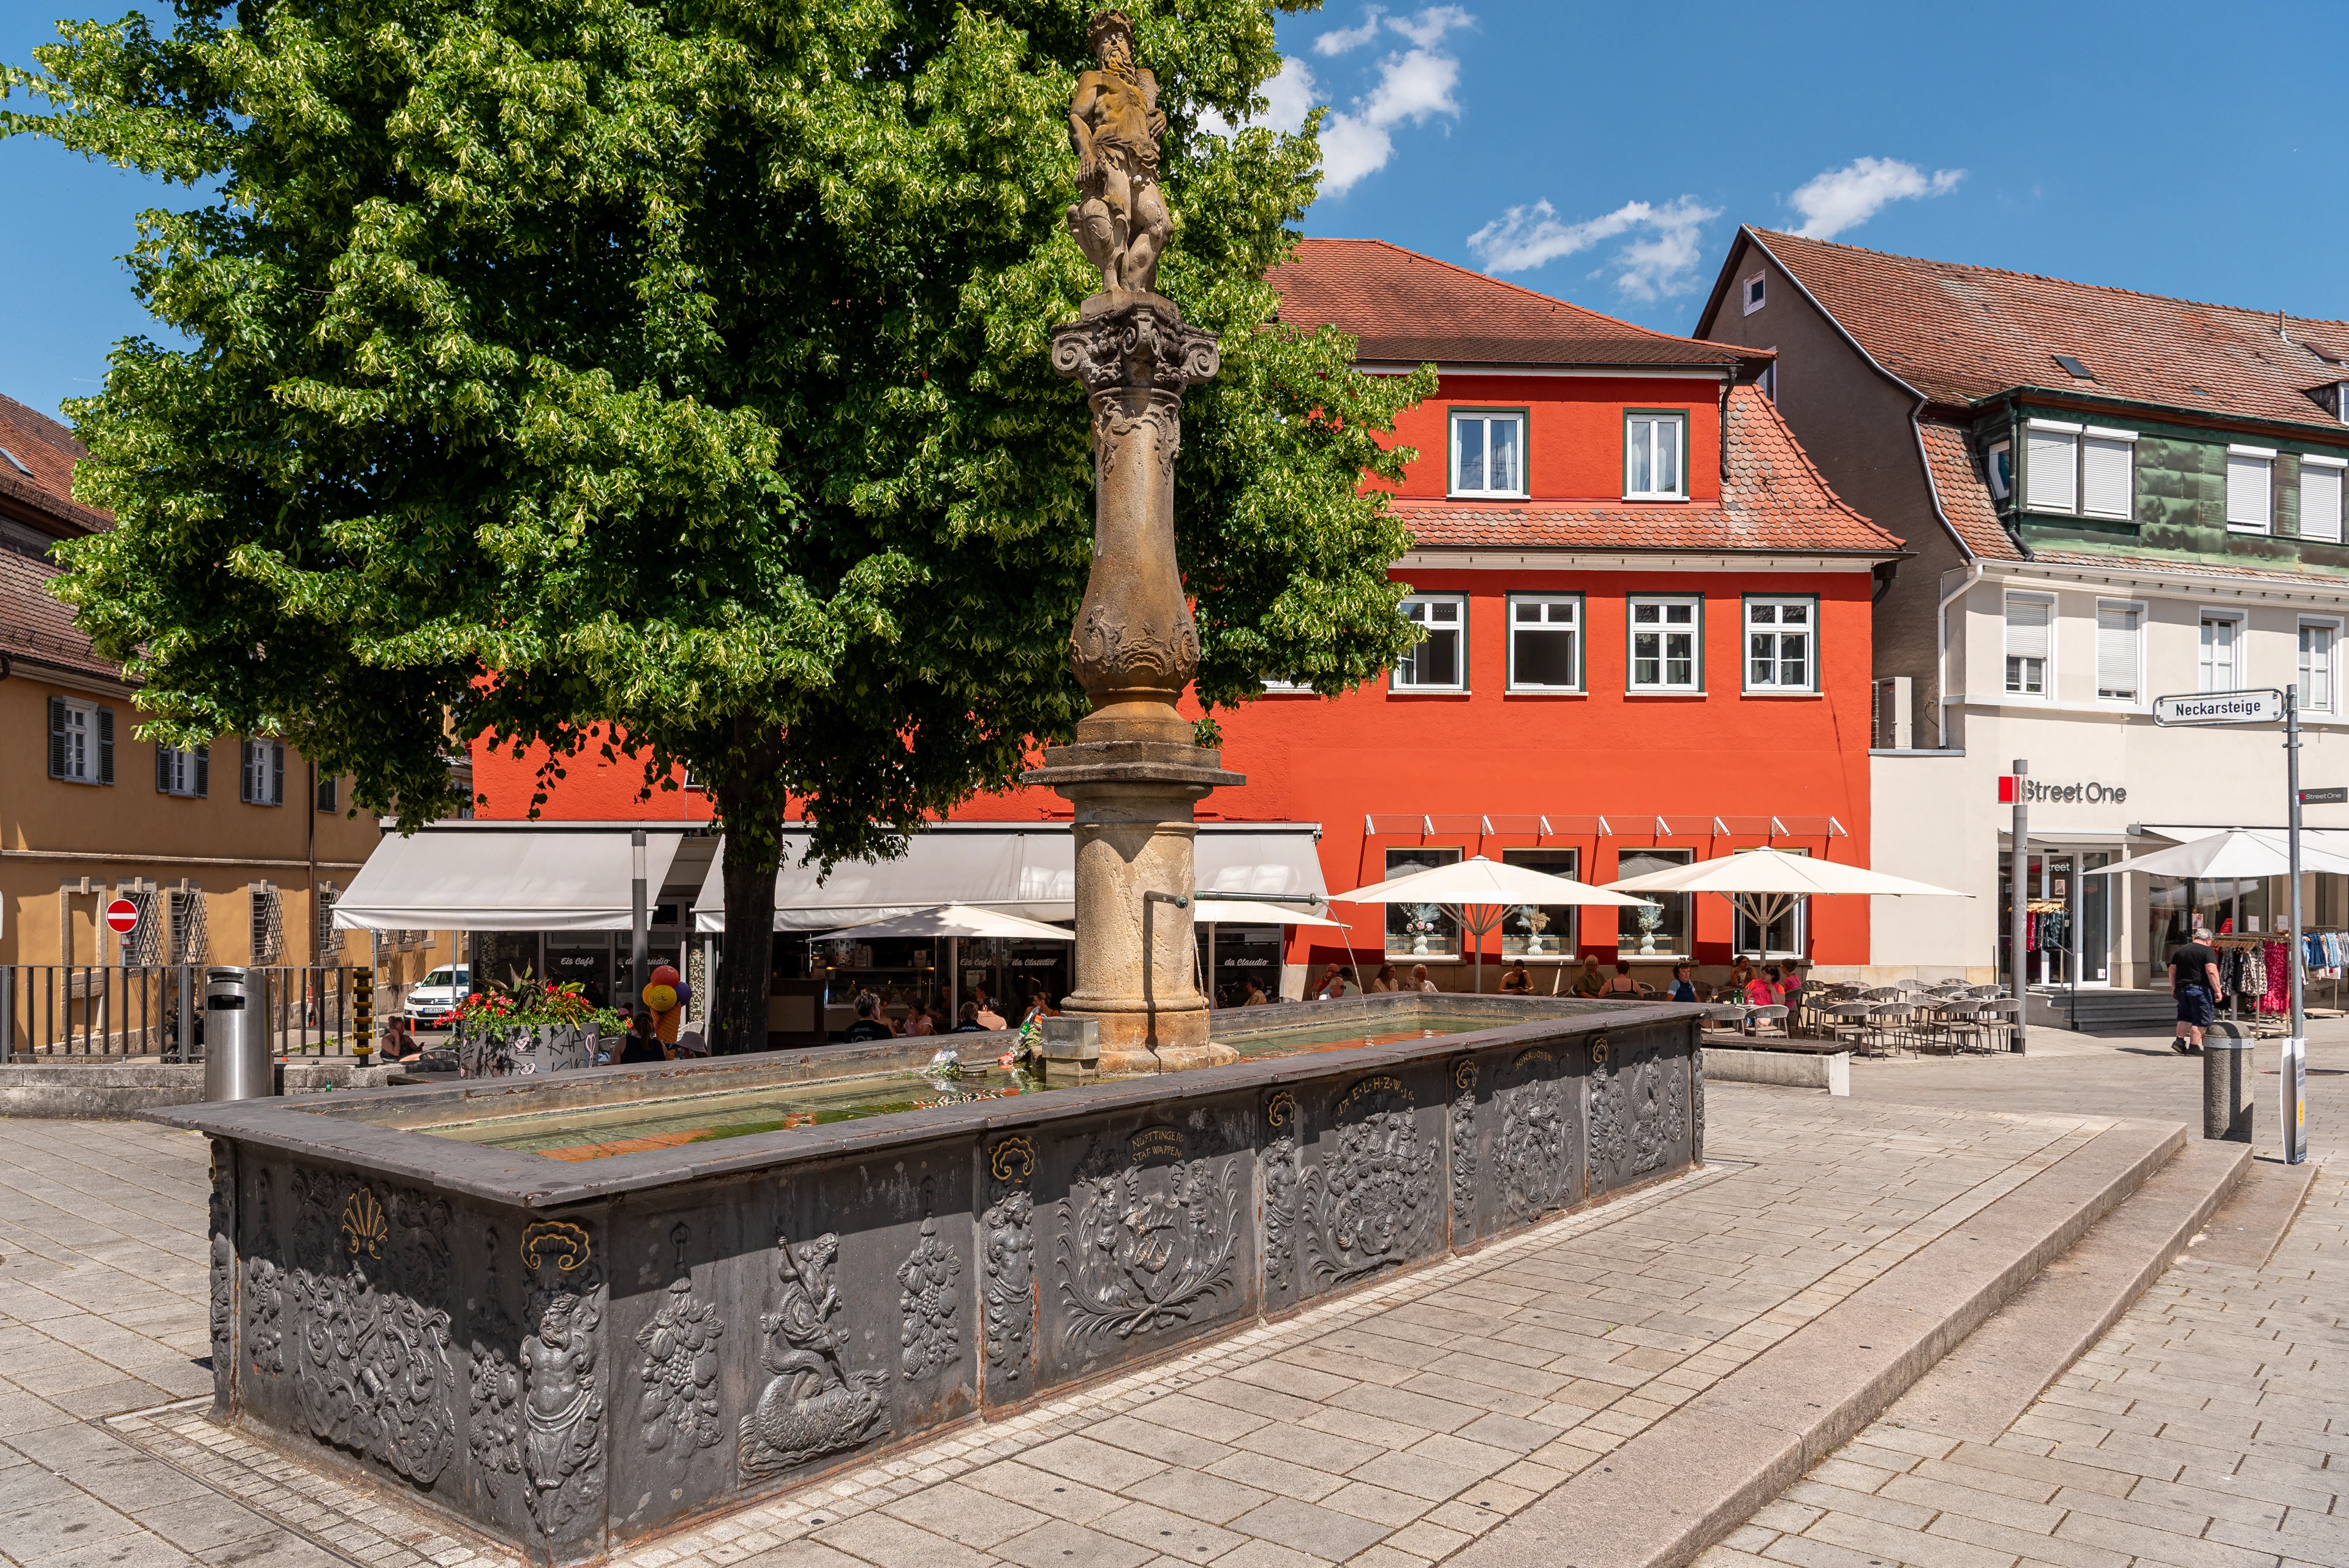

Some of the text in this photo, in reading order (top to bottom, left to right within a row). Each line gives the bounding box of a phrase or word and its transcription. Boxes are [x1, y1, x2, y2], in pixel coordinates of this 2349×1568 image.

[2176, 700, 2261, 717] Neckarsteige
[2021, 780, 2127, 804] Street One
[1024, 958, 1057, 967] Claudio
